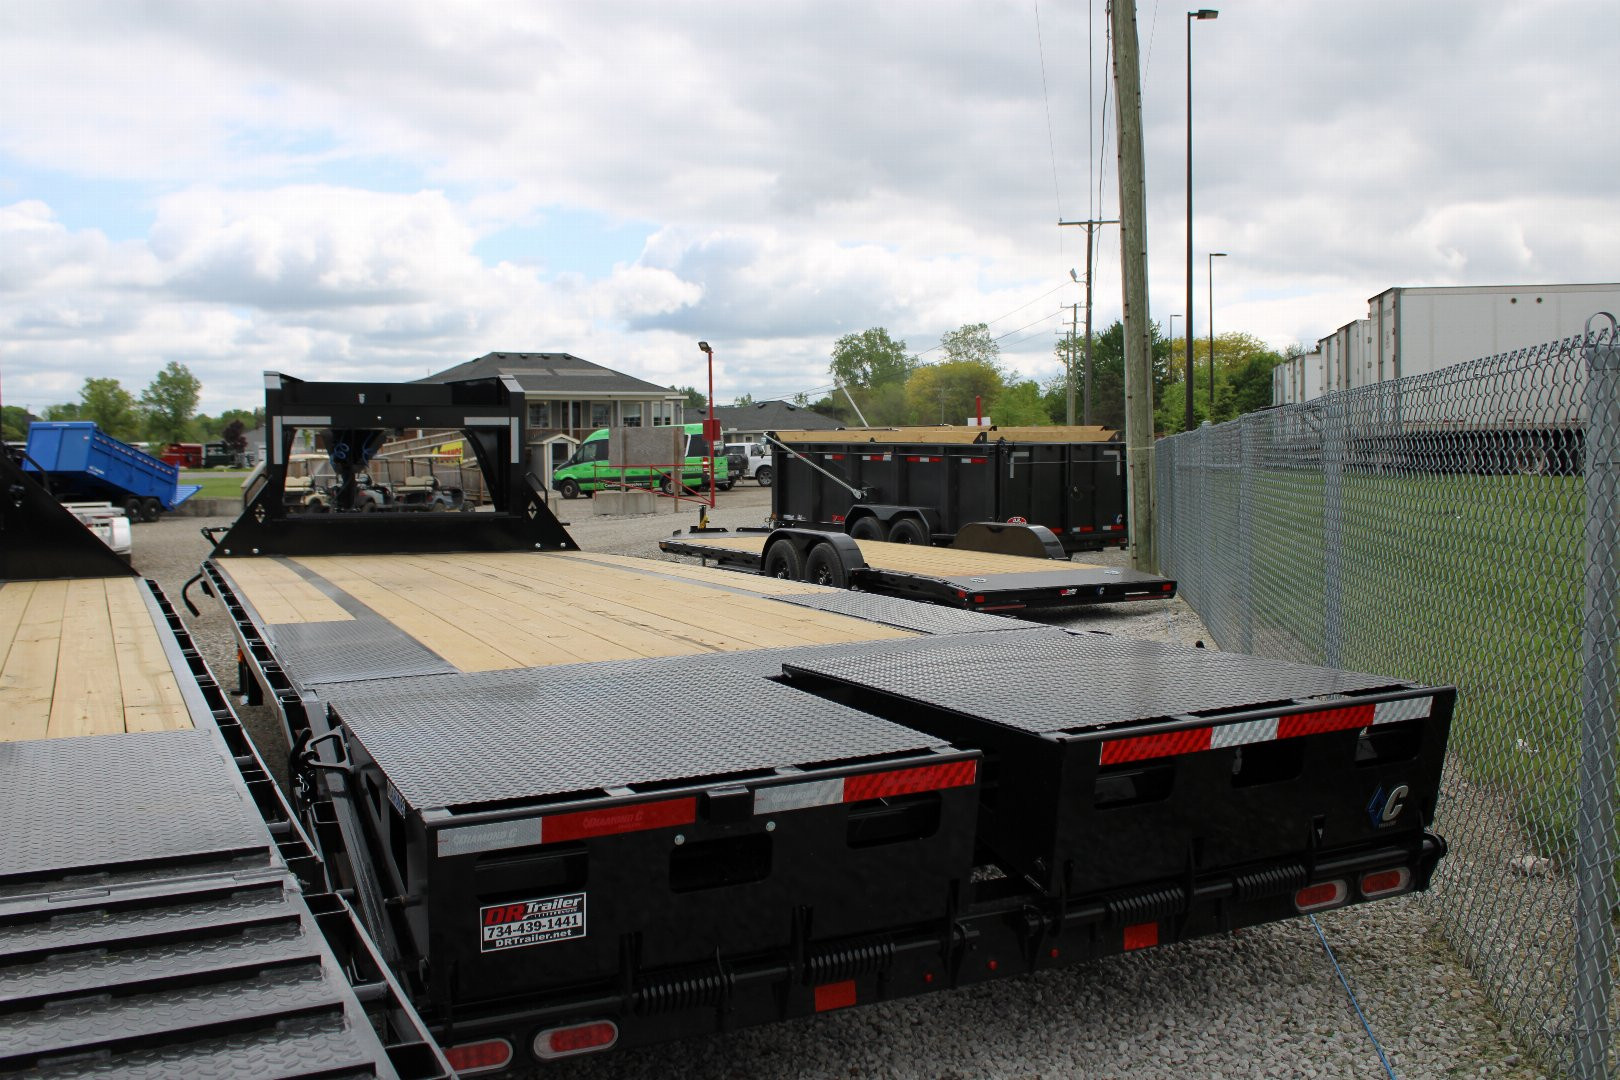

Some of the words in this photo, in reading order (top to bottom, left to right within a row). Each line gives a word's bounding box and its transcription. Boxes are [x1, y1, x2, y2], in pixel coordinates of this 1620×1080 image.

[526, 897, 582, 914] Trailer
[487, 915, 578, 939] 734-439-1441
[495, 929, 572, 948] DRTrailer.net
